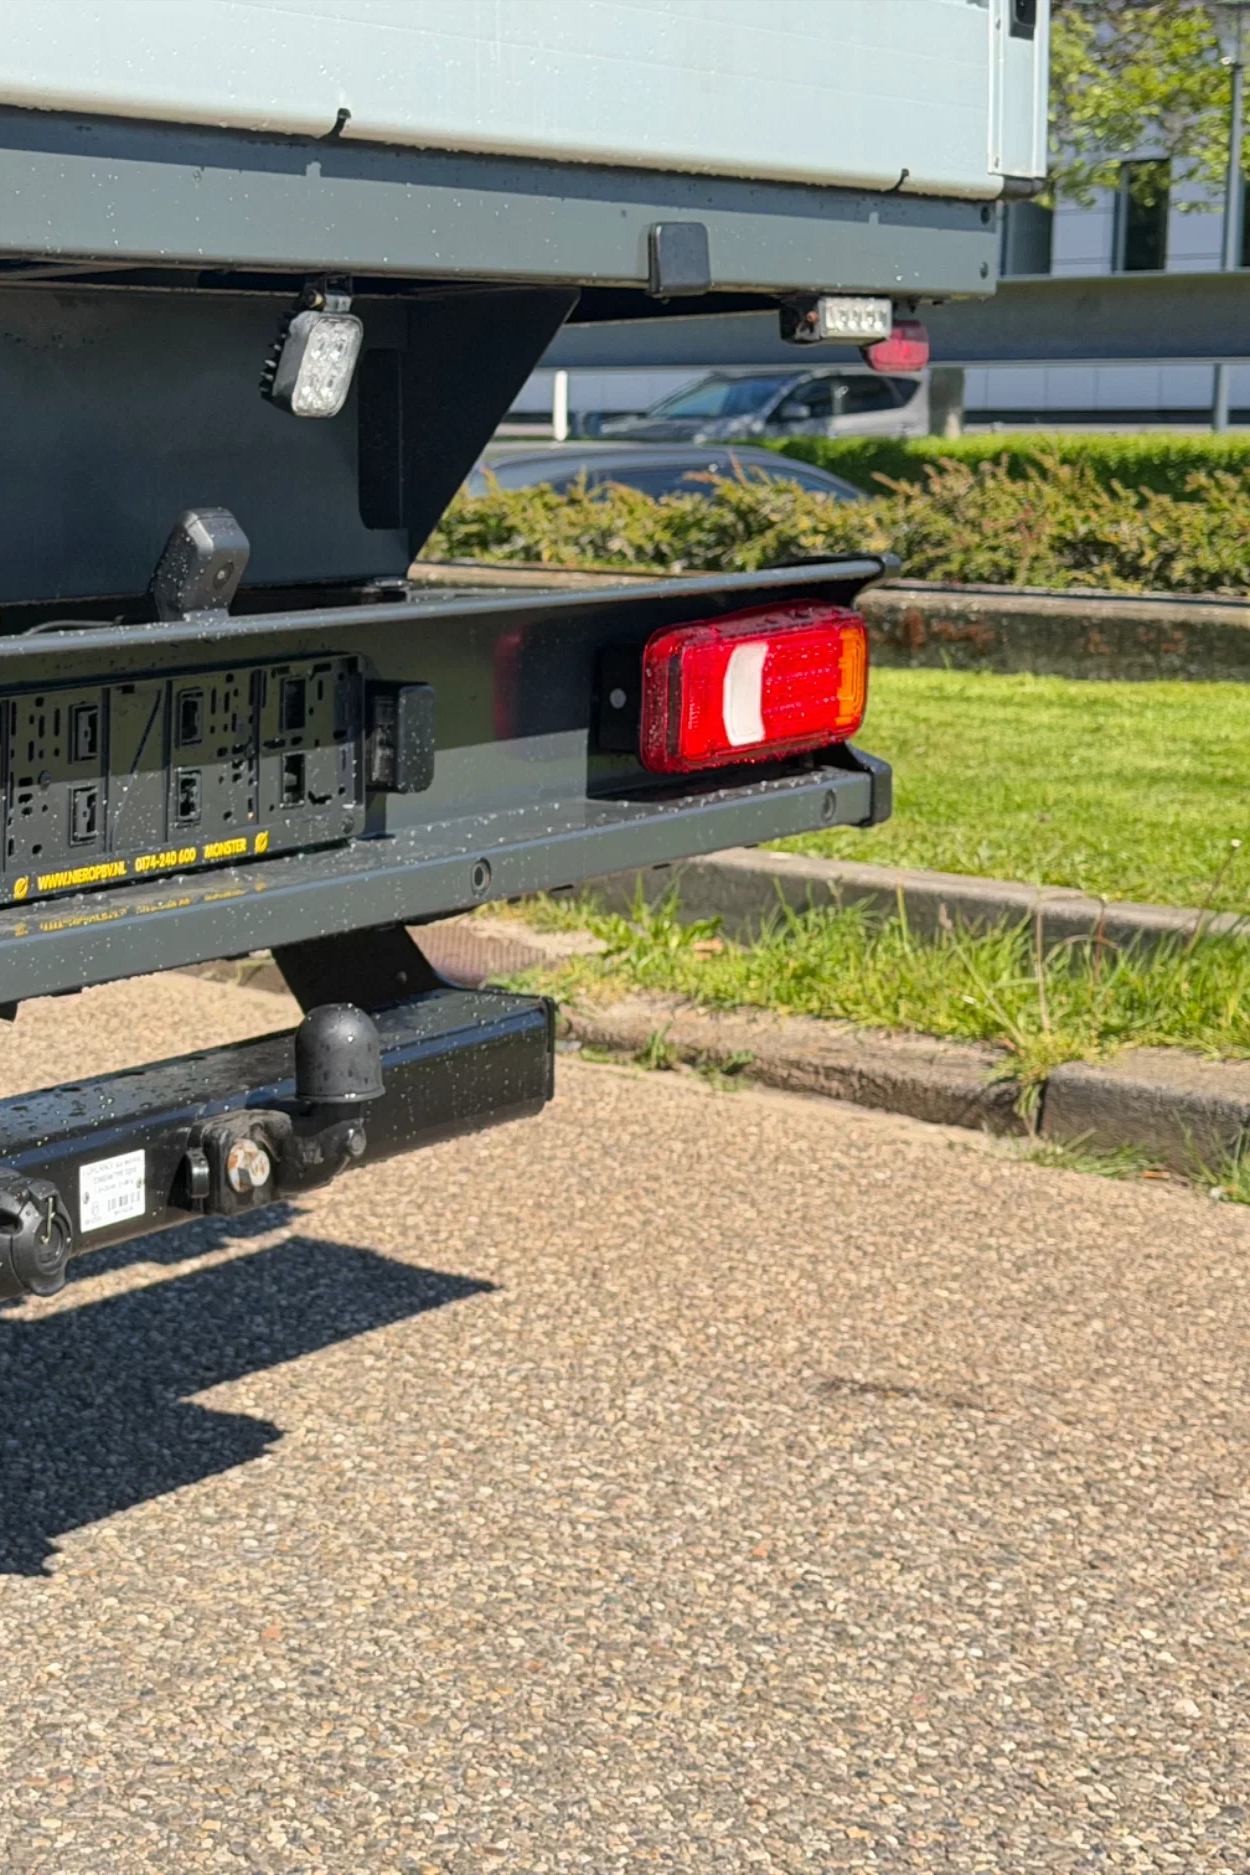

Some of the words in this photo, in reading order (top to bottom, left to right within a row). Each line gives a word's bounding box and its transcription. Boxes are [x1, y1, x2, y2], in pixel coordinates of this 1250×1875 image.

[135, 850, 176, 872] 0174-240
[178, 847, 196, 865] 600
[204, 838, 247, 858] MONSTER
